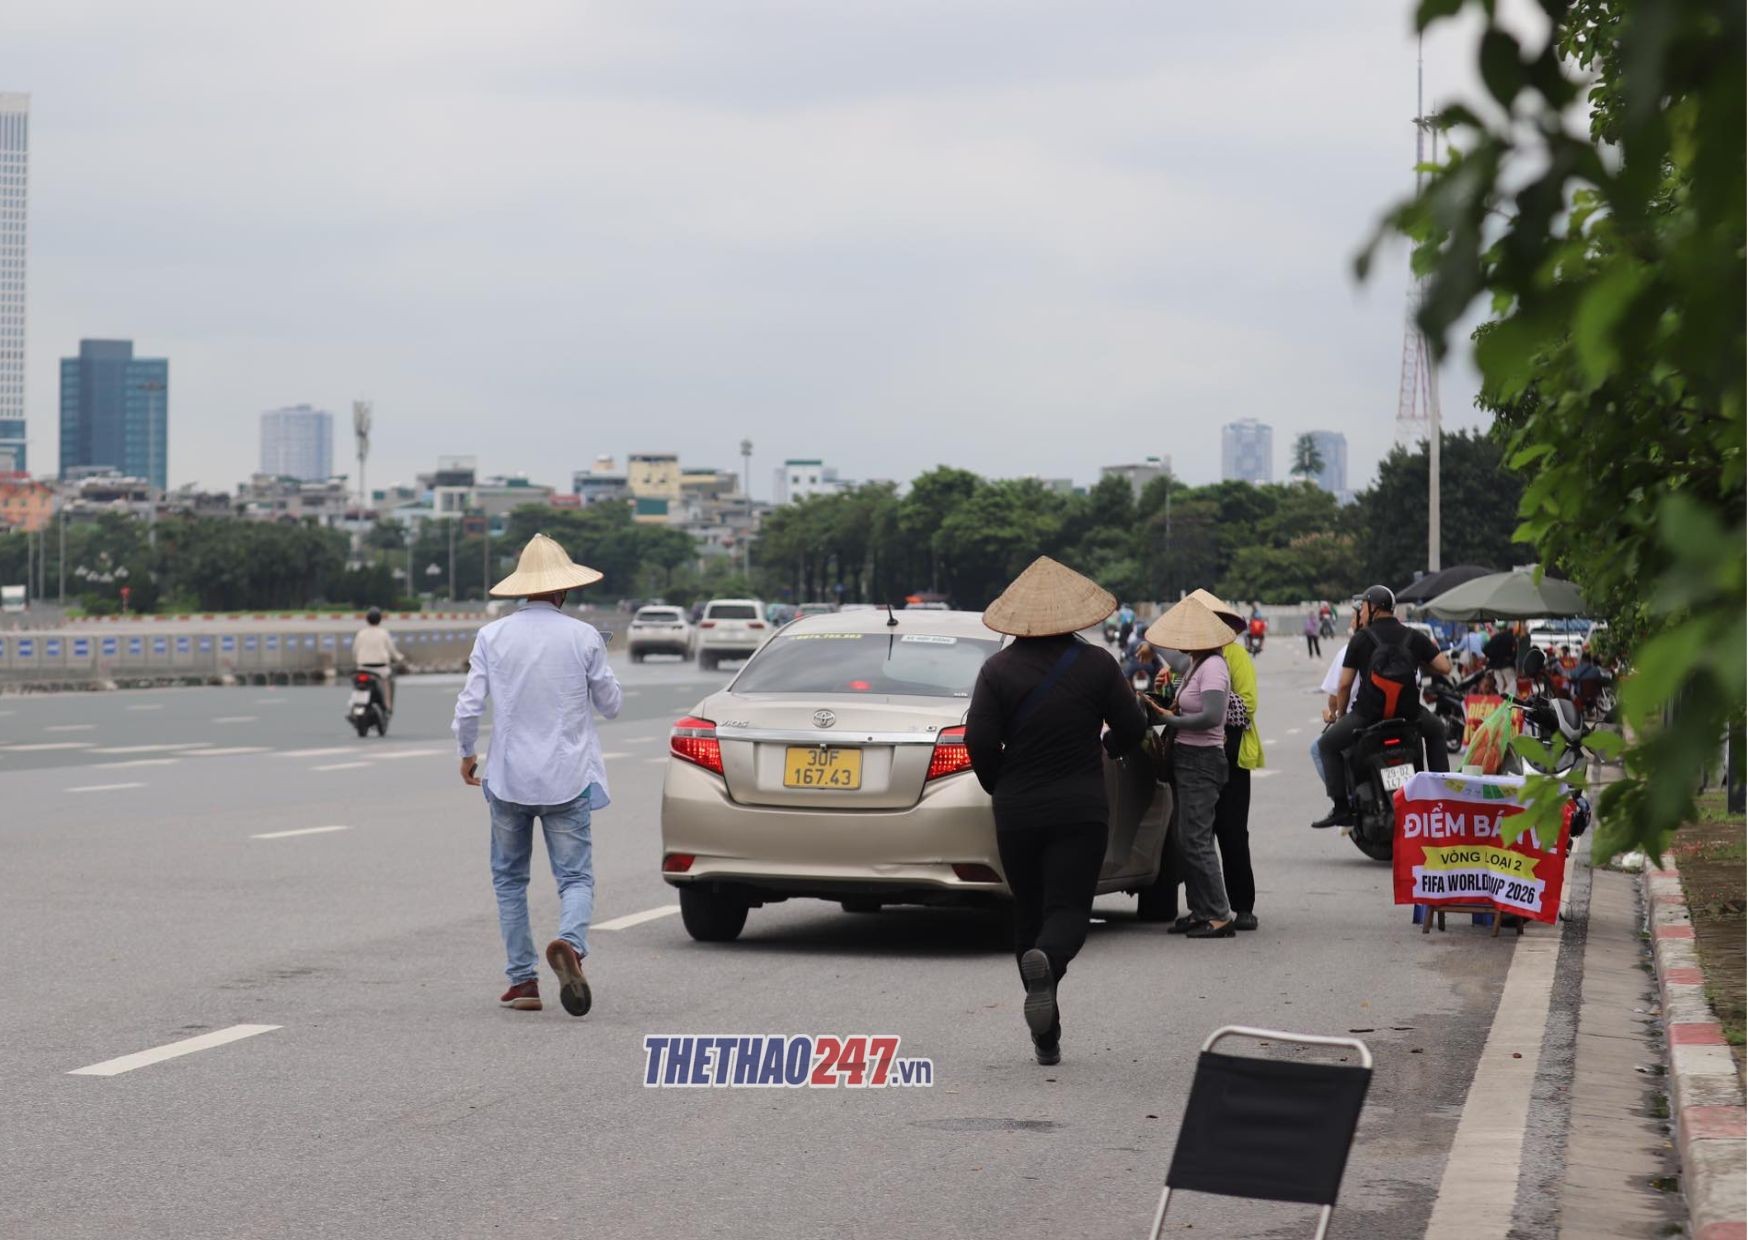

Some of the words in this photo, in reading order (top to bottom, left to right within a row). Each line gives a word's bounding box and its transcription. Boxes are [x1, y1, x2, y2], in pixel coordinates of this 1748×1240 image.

[808, 750, 839, 766] 30F
[794, 770, 851, 786] 167.43
[1404, 803, 1465, 839] ĐIỂM
[1441, 850, 1481, 865] VÒNG
[1514, 860, 1522, 871] 2
[1422, 874, 1445, 893] FIFA
[1449, 873, 1488, 893] WORLD
[1505, 881, 1536, 905] 2026
